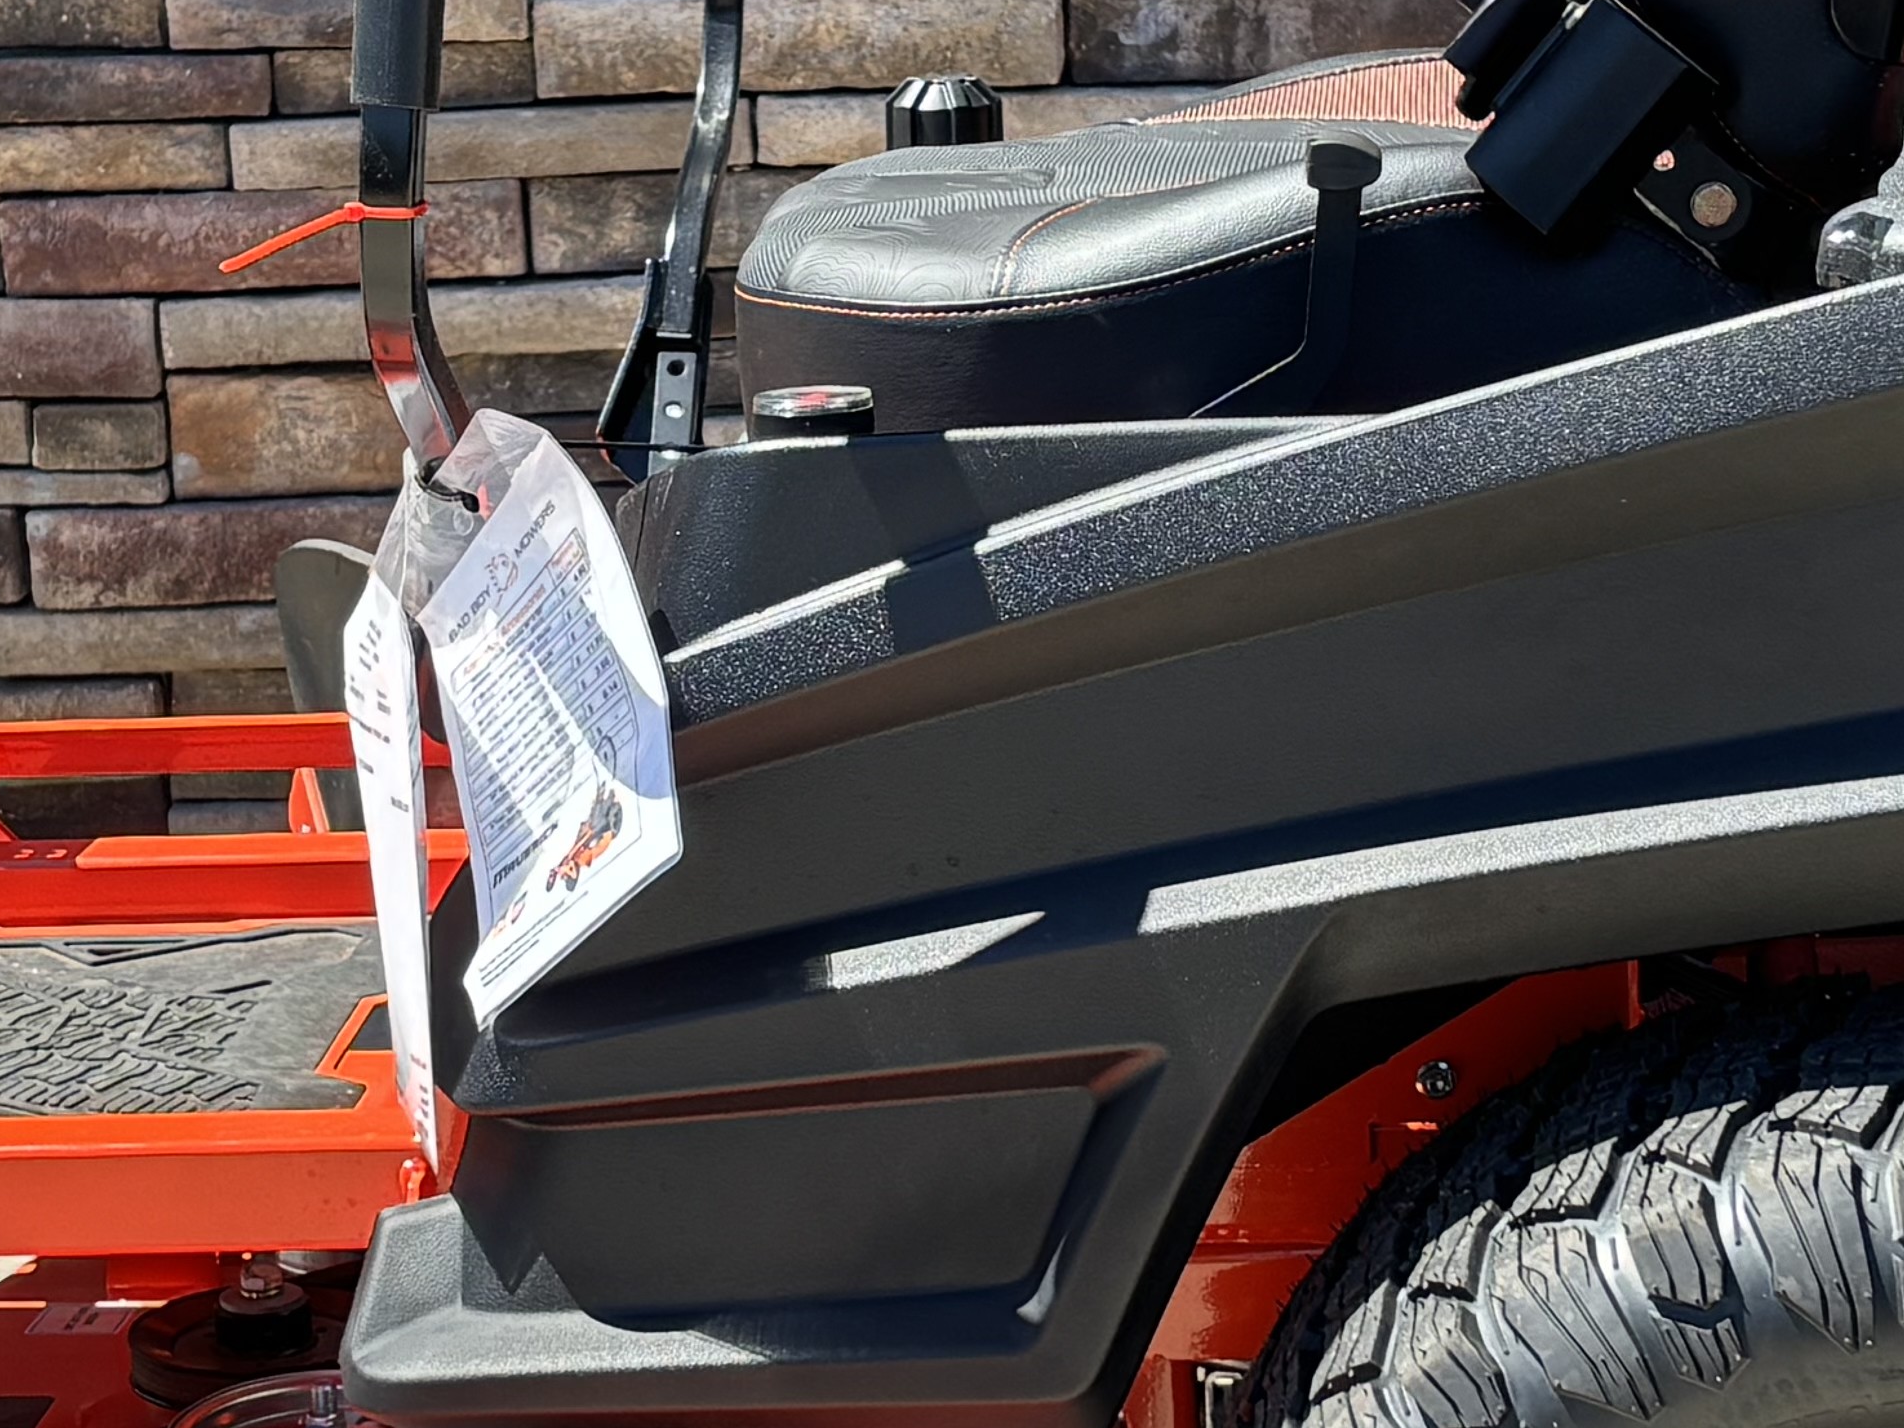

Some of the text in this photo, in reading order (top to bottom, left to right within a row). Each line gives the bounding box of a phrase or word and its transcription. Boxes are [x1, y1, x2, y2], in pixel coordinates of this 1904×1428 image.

[448, 499, 556, 644] BAD BOY MOWERS
